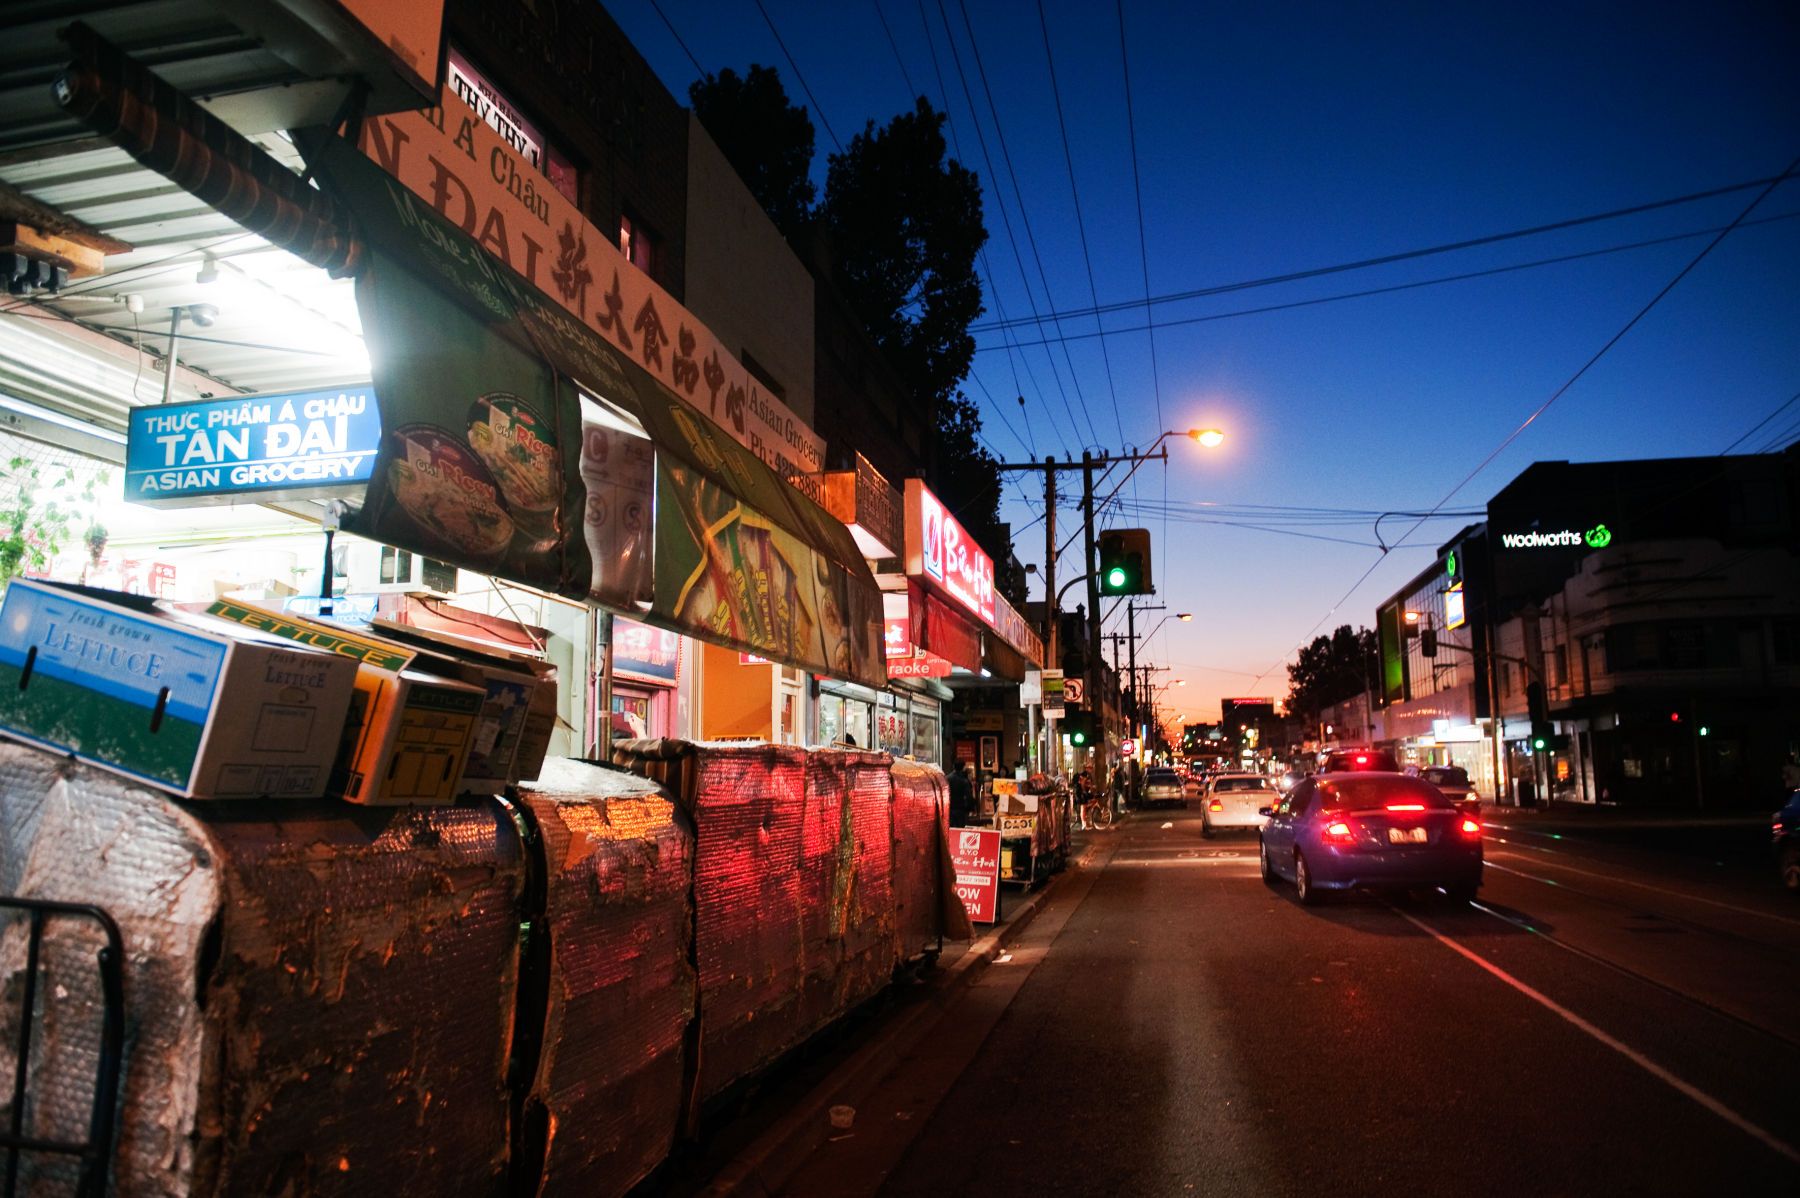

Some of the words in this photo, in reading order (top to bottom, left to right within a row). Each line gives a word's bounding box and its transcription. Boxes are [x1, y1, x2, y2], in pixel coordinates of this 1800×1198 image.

[454, 72, 491, 122] THY
[493, 110, 528, 156] THY
[491, 146, 551, 227] Châu
[156, 428, 250, 467] TÂN
[748, 386, 784, 438] Asian
[785, 417, 824, 475] Grocery
[139, 468, 221, 493] ASIAN
[230, 457, 363, 485] GROCERY
[42, 622, 166, 681] LETTUCE
[109, 621, 152, 643] grown
[216, 605, 393, 668] LETTUCE
[264, 665, 326, 689] LETTUCE
[888, 662, 930, 675] raoke
[957, 887, 981, 900] OW
